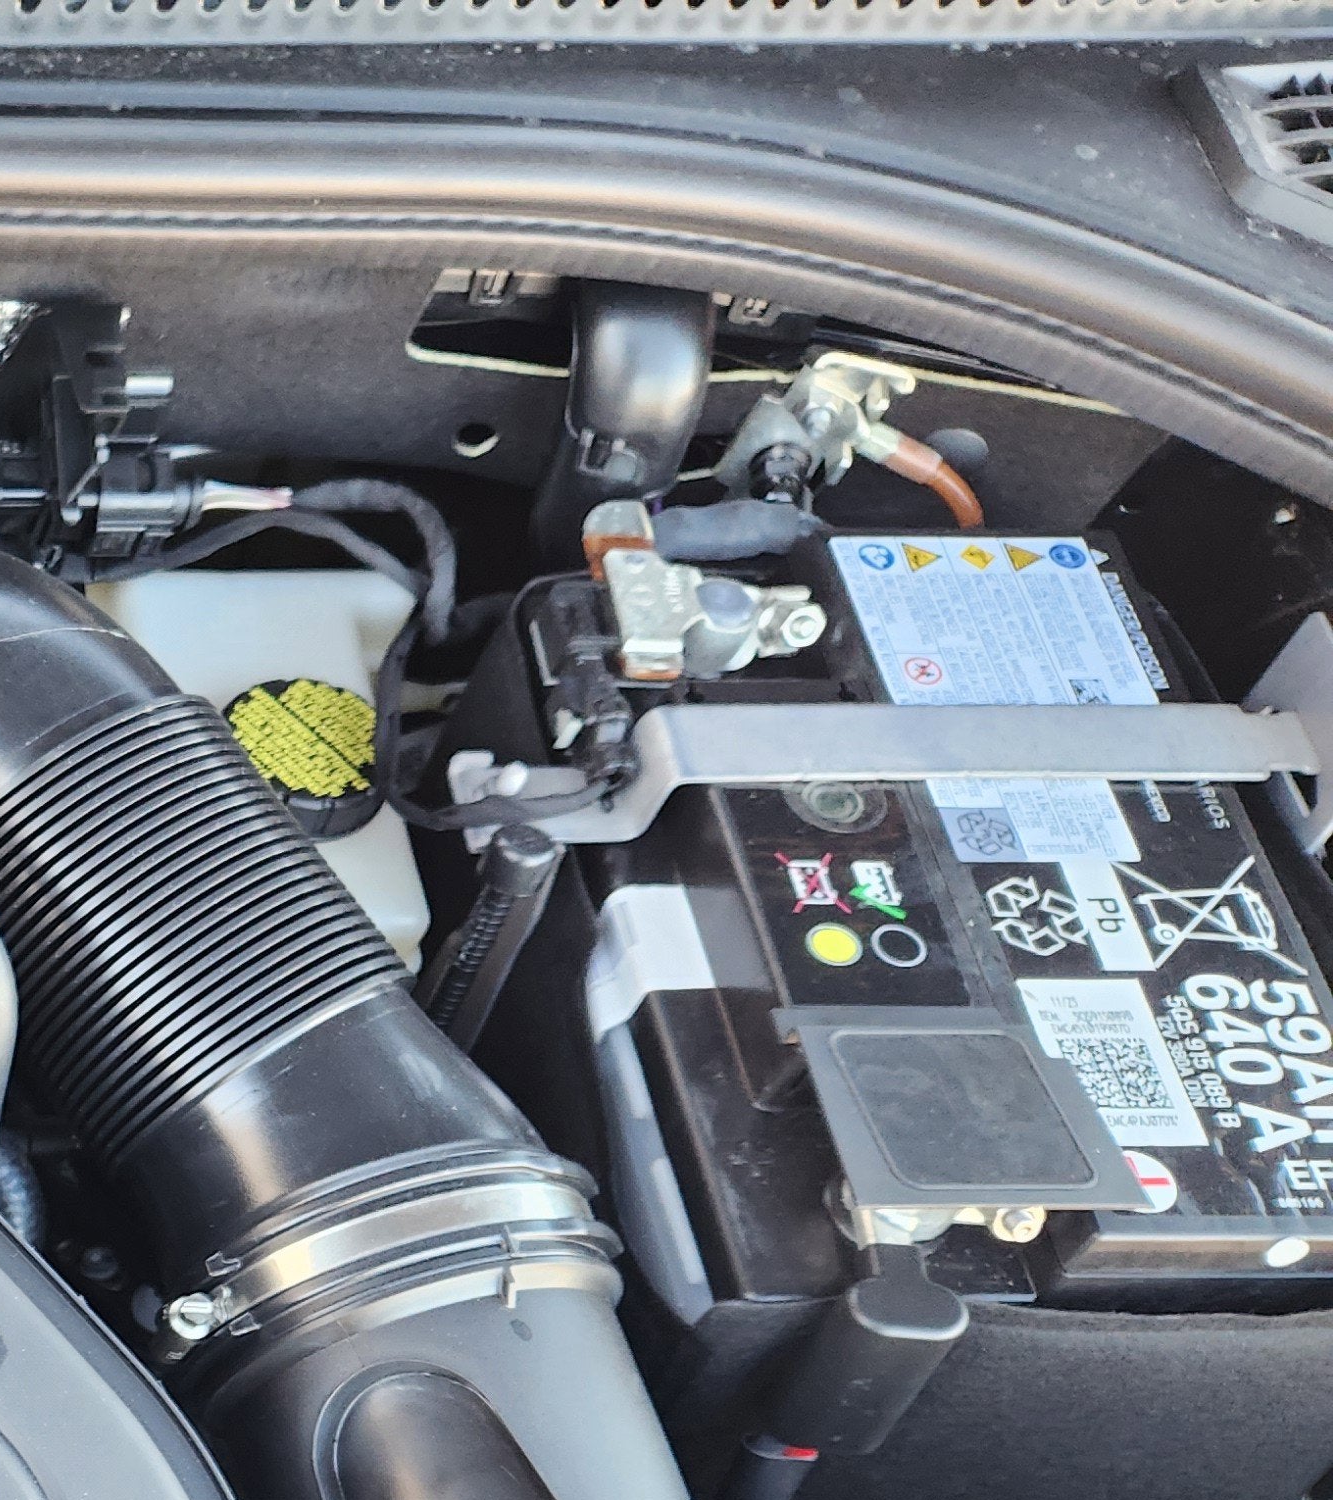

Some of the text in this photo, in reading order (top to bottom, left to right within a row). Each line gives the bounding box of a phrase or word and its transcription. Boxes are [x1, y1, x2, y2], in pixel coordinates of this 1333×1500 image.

[1086, 897, 1127, 935] Pb
[1155, 1015, 1181, 1040] 12V
[1183, 973, 1284, 1087] 640
[1237, 1101, 1313, 1154] A
[1184, 1036, 1215, 1071] 915
[1199, 1071, 1233, 1110] 089
